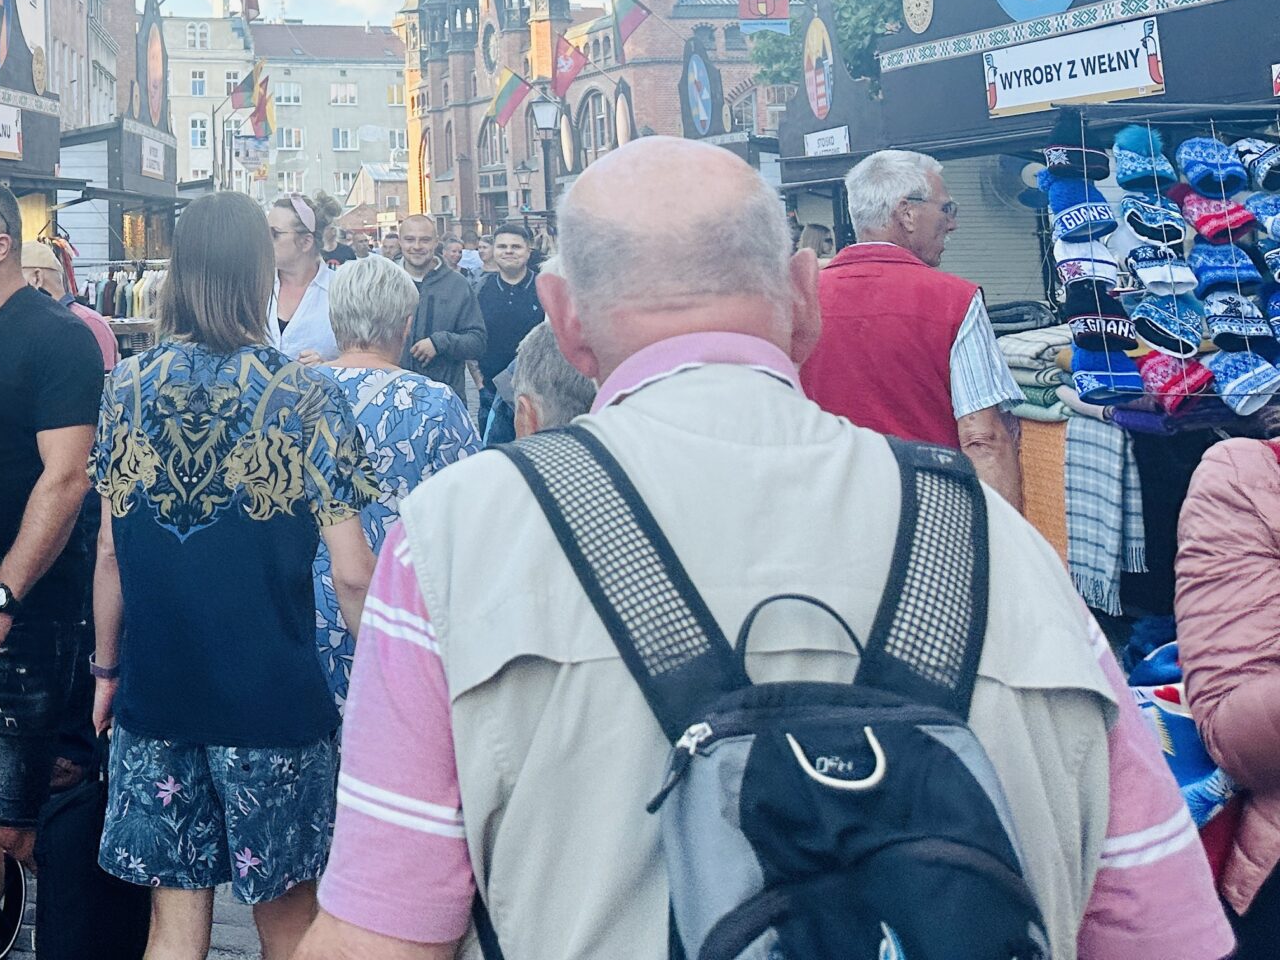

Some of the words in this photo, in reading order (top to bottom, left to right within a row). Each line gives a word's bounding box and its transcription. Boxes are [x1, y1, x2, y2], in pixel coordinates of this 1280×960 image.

[999, 62, 1063, 90] WYROBY
[1067, 59, 1077, 79] Z
[1081, 47, 1140, 76] WEŁNY
